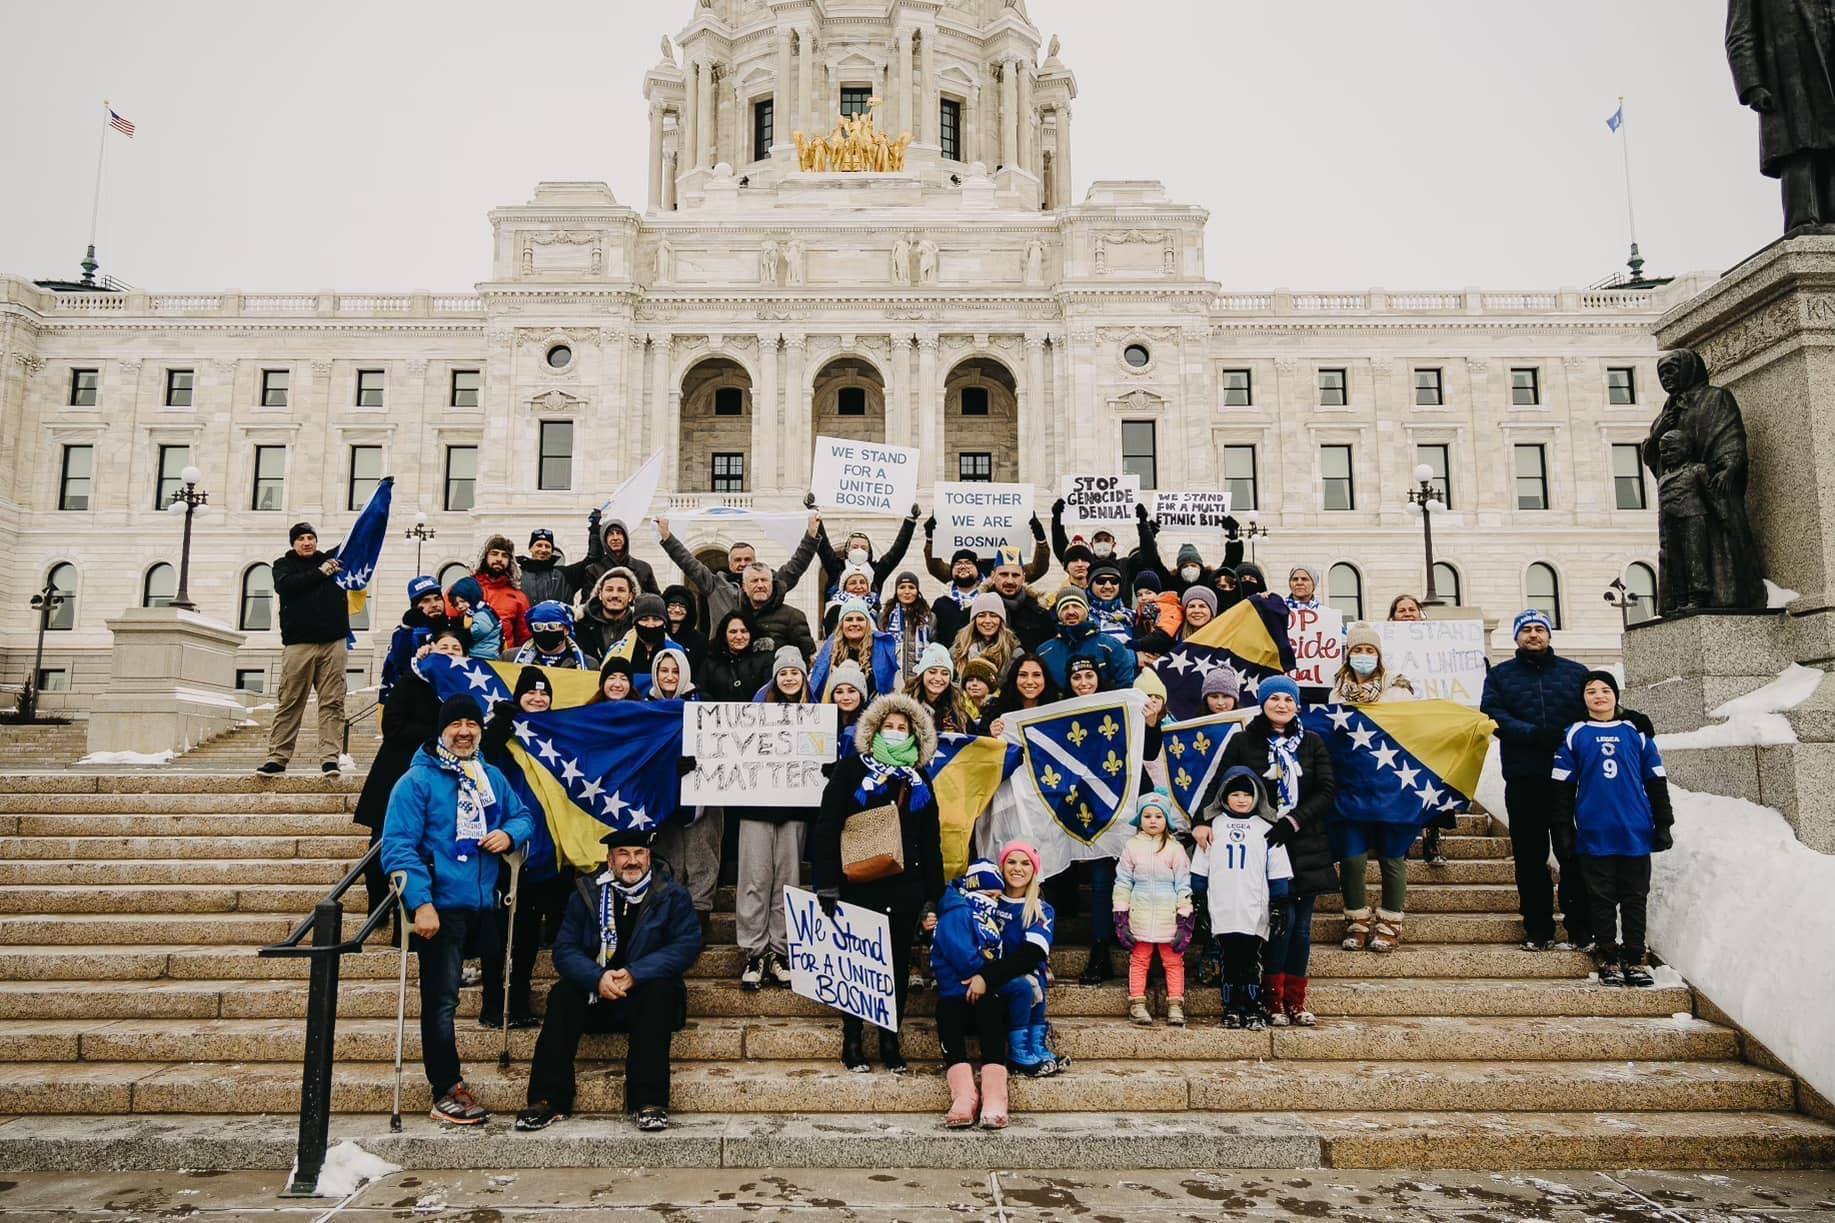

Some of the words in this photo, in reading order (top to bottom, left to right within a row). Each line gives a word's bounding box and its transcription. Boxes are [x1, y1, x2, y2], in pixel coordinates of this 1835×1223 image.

[832, 446, 854, 459] WE
[861, 449, 907, 464] STAND
[844, 464, 871, 478] FOR
[876, 468, 886, 479] A
[840, 480, 894, 495] UNITED
[1073, 477, 1118, 492] STOP
[836, 492, 890, 508] BOSNIA
[945, 492, 1022, 505] TOGETHER
[1067, 489, 1133, 505] GENOCIDE
[1184, 493, 1223, 501] STAND
[1079, 505, 1131, 519] DENIAL
[1156, 502, 1176, 511] FOR
[1180, 503, 1188, 512] A
[1192, 503, 1225, 513] MULTI
[952, 515, 975, 527] WE
[983, 516, 1012, 527] ARE
[1156, 512, 1196, 526] ETHNIC
[954, 536, 1008, 547] BOSNIA
[1426, 648, 1484, 673] UNITED
[696, 703, 821, 730] MUSLIM
[696, 731, 792, 759] LIVES
[694, 760, 820, 791] MATTER
[1602, 758, 1618, 779] 9
[1226, 843, 1246, 870] 11
[786, 892, 826, 946] We
[830, 904, 887, 966] Stand
[789, 943, 819, 973] FOR
[824, 954, 835, 976] A
[838, 956, 894, 996] UNITED
[815, 974, 889, 1025] BOSNIA
